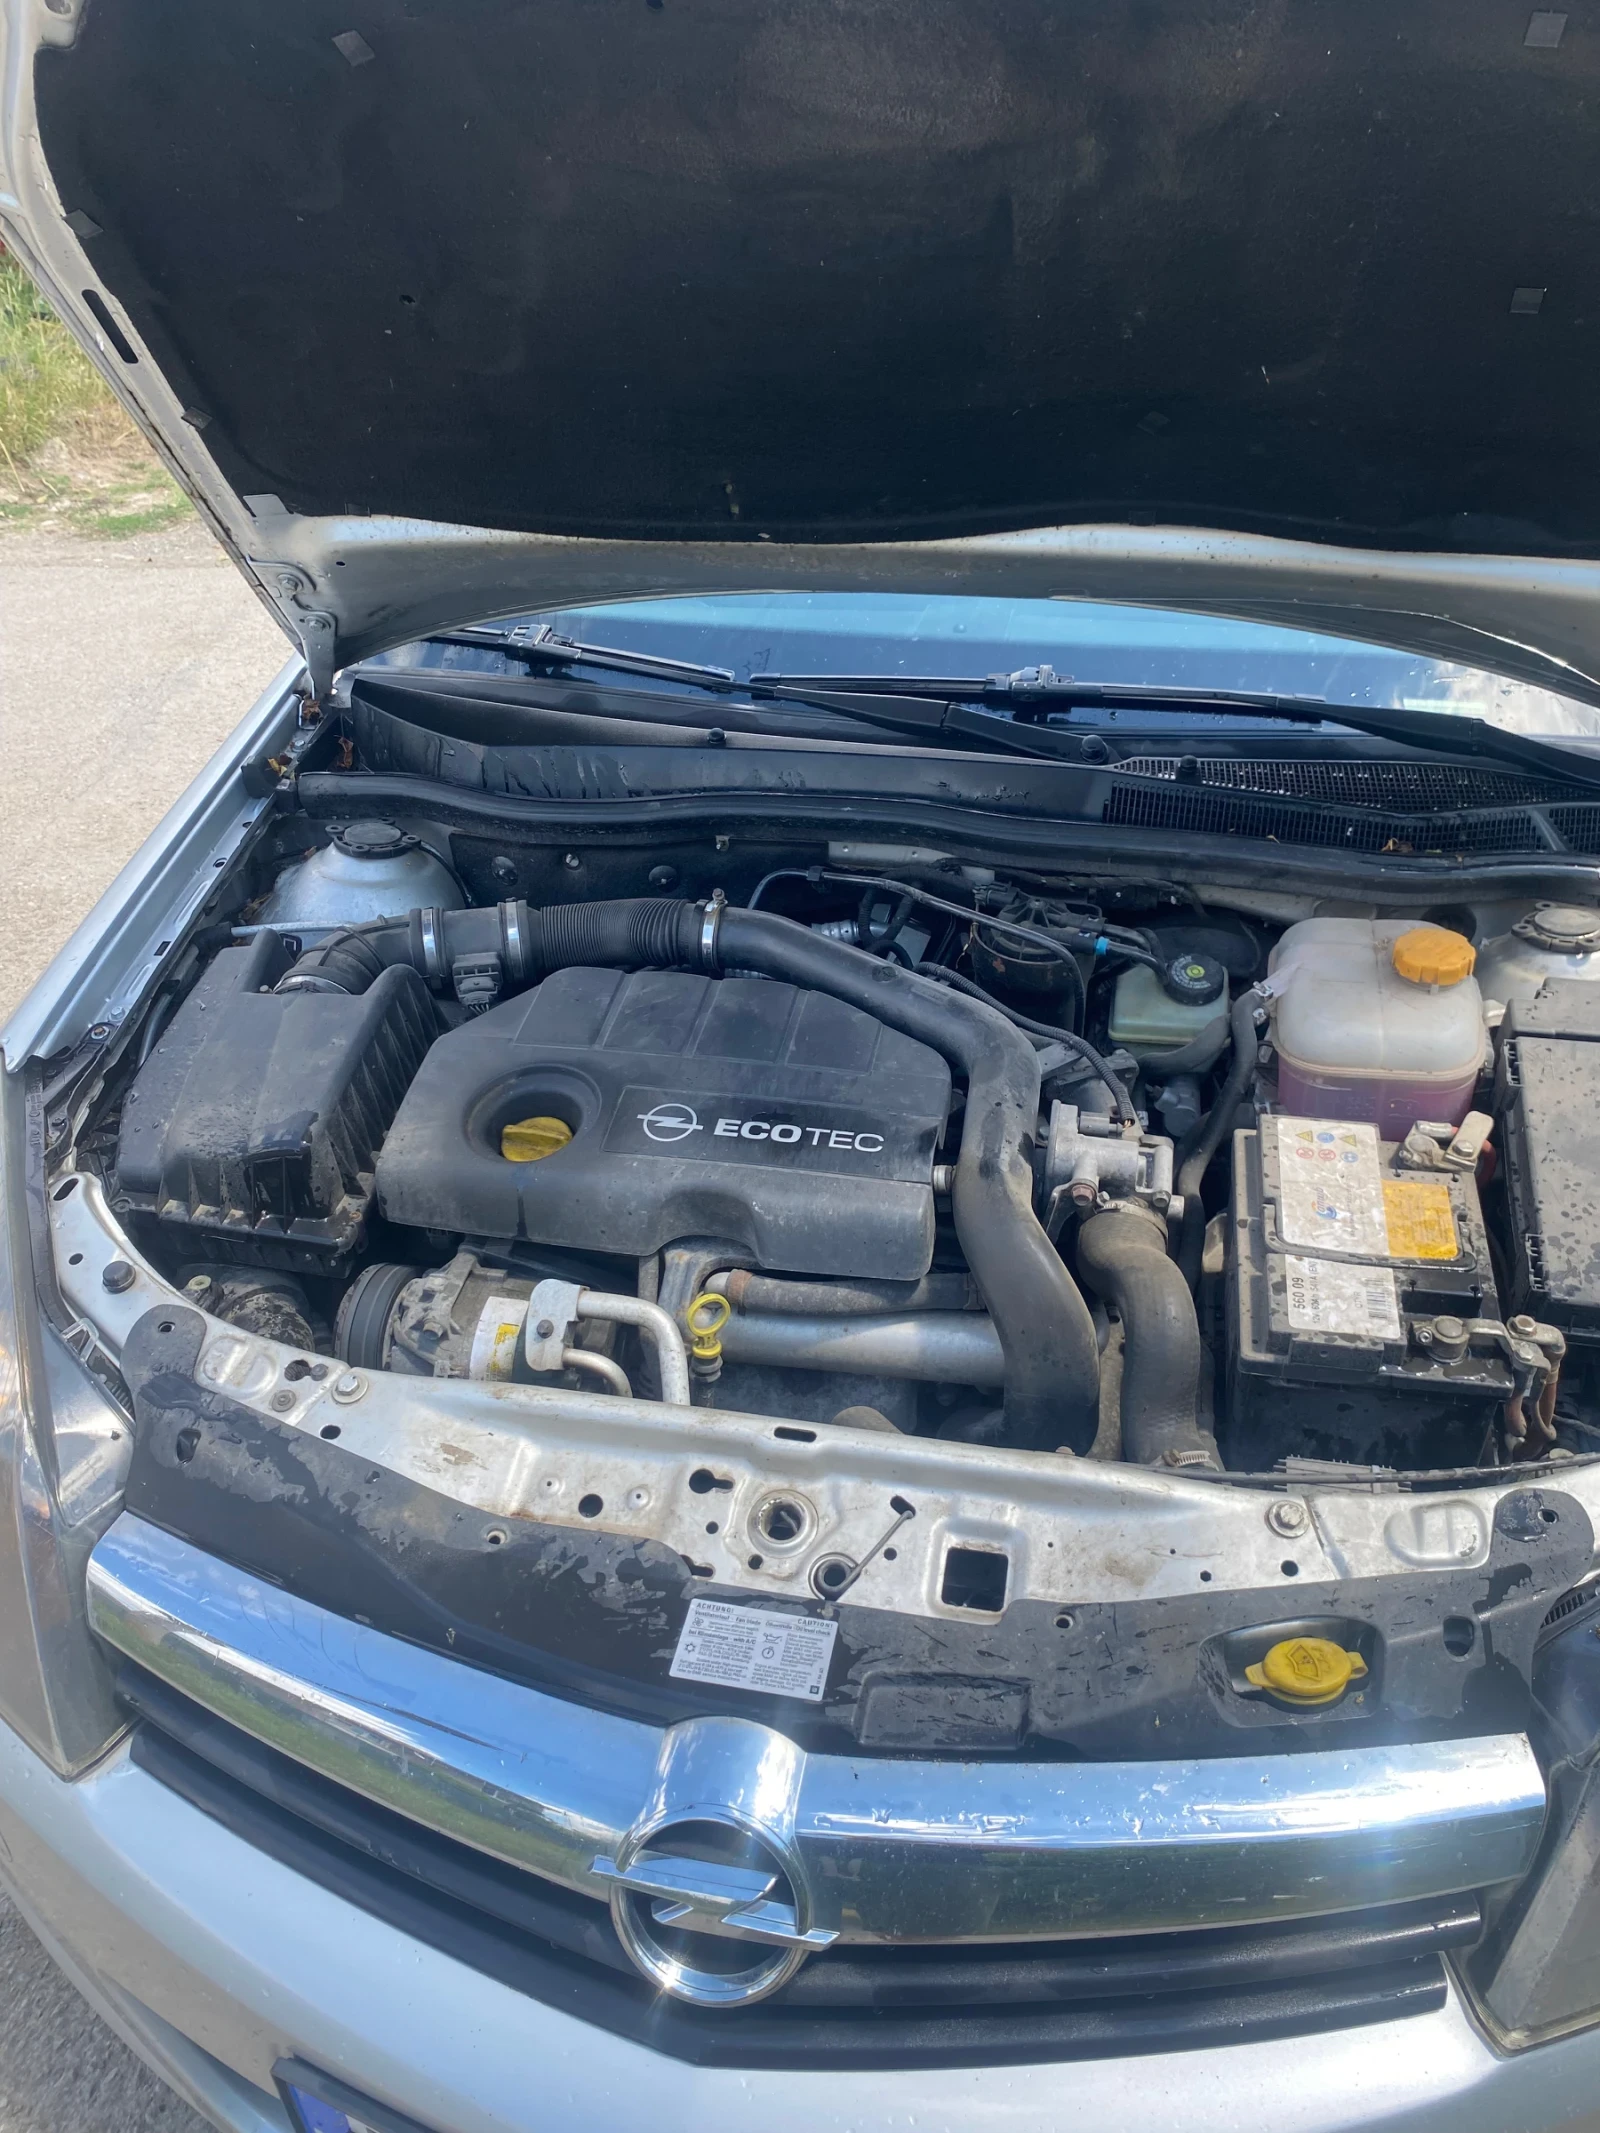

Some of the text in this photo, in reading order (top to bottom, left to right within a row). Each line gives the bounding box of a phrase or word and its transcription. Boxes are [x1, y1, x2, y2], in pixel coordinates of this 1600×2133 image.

[713, 1118, 885, 1152] ECOTEC
[1291, 1277, 1306, 1310] 560 09
[696, 1602, 734, 1613] ACHTUNG!
[797, 1618, 834, 1628] CAUTION!
